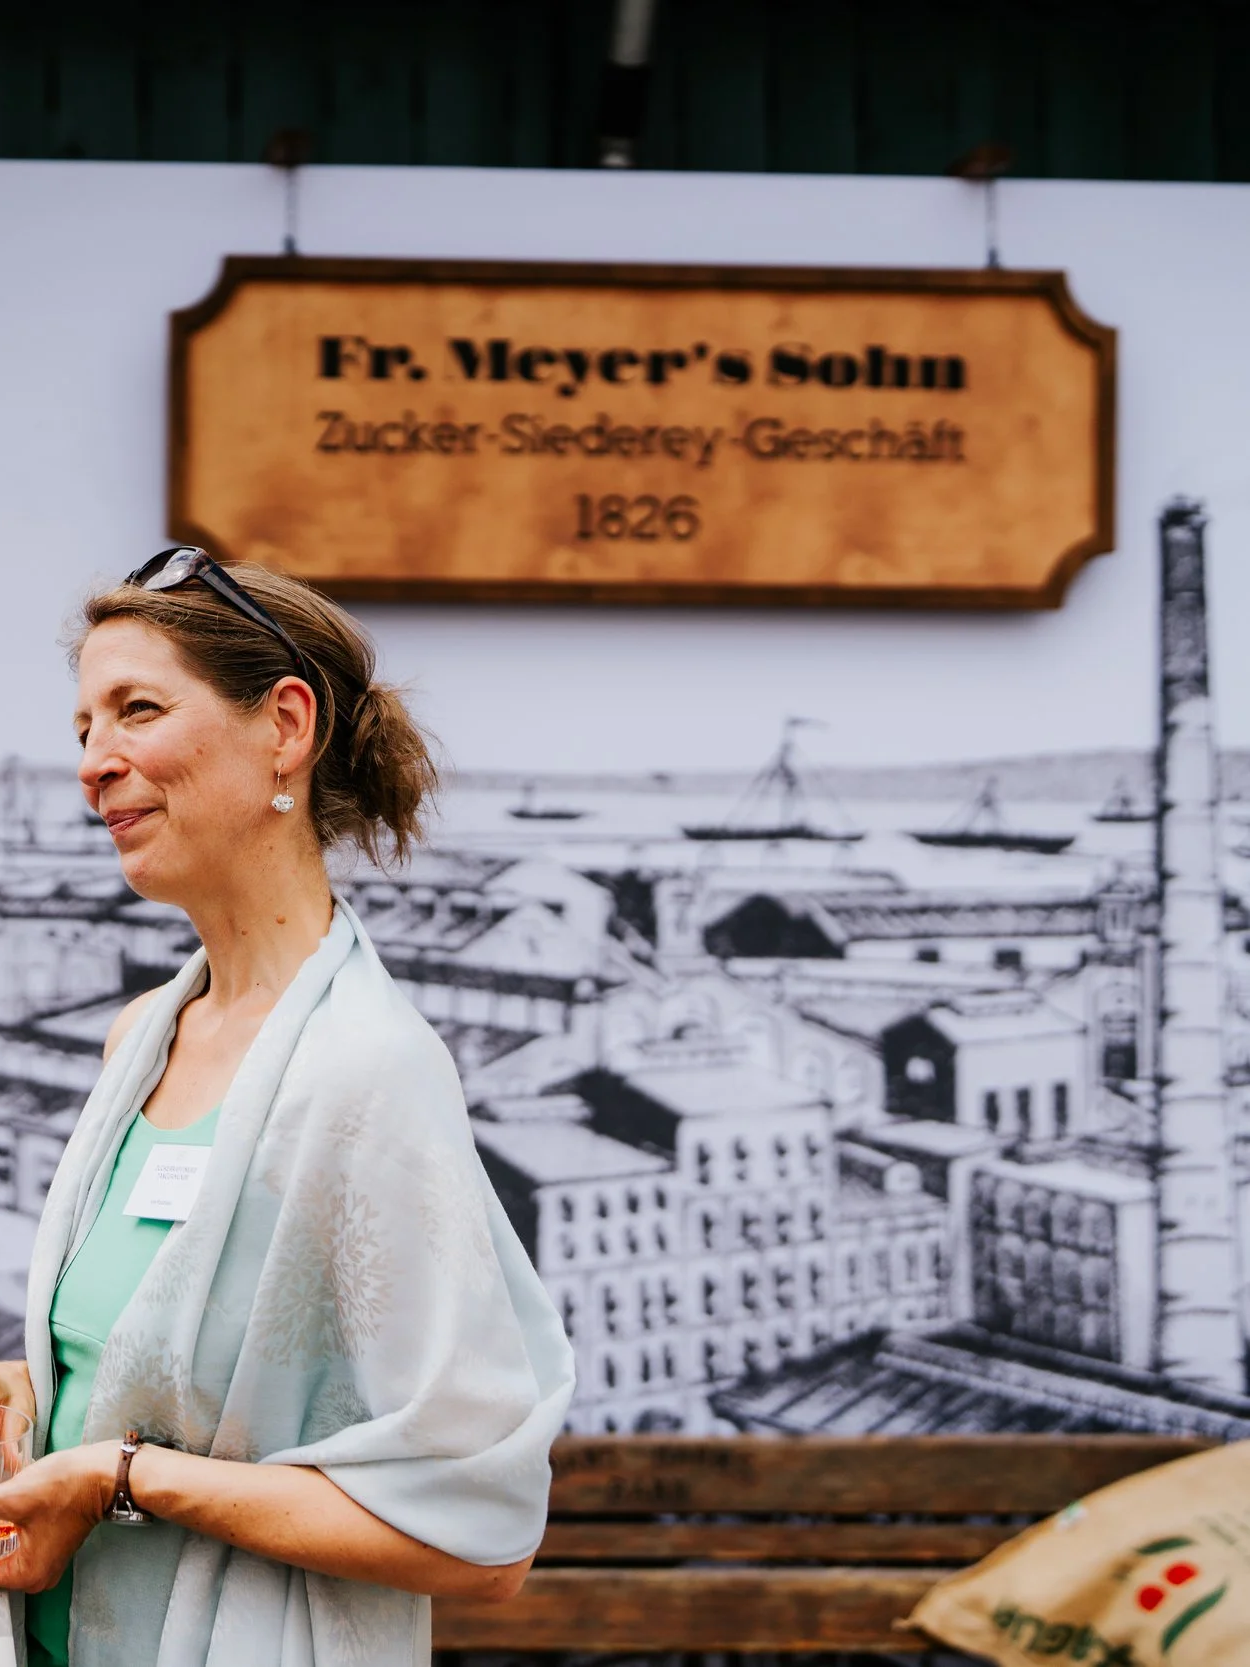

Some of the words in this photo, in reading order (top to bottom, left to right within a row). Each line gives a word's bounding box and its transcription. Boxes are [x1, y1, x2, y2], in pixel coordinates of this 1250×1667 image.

[318, 334, 427, 382] Fr.
[446, 337, 750, 398] Meyer's
[767, 342, 965, 391] Sohn
[316, 408, 965, 471] Zucker-Siederey-Geschäft
[573, 493, 702, 543] 1826
